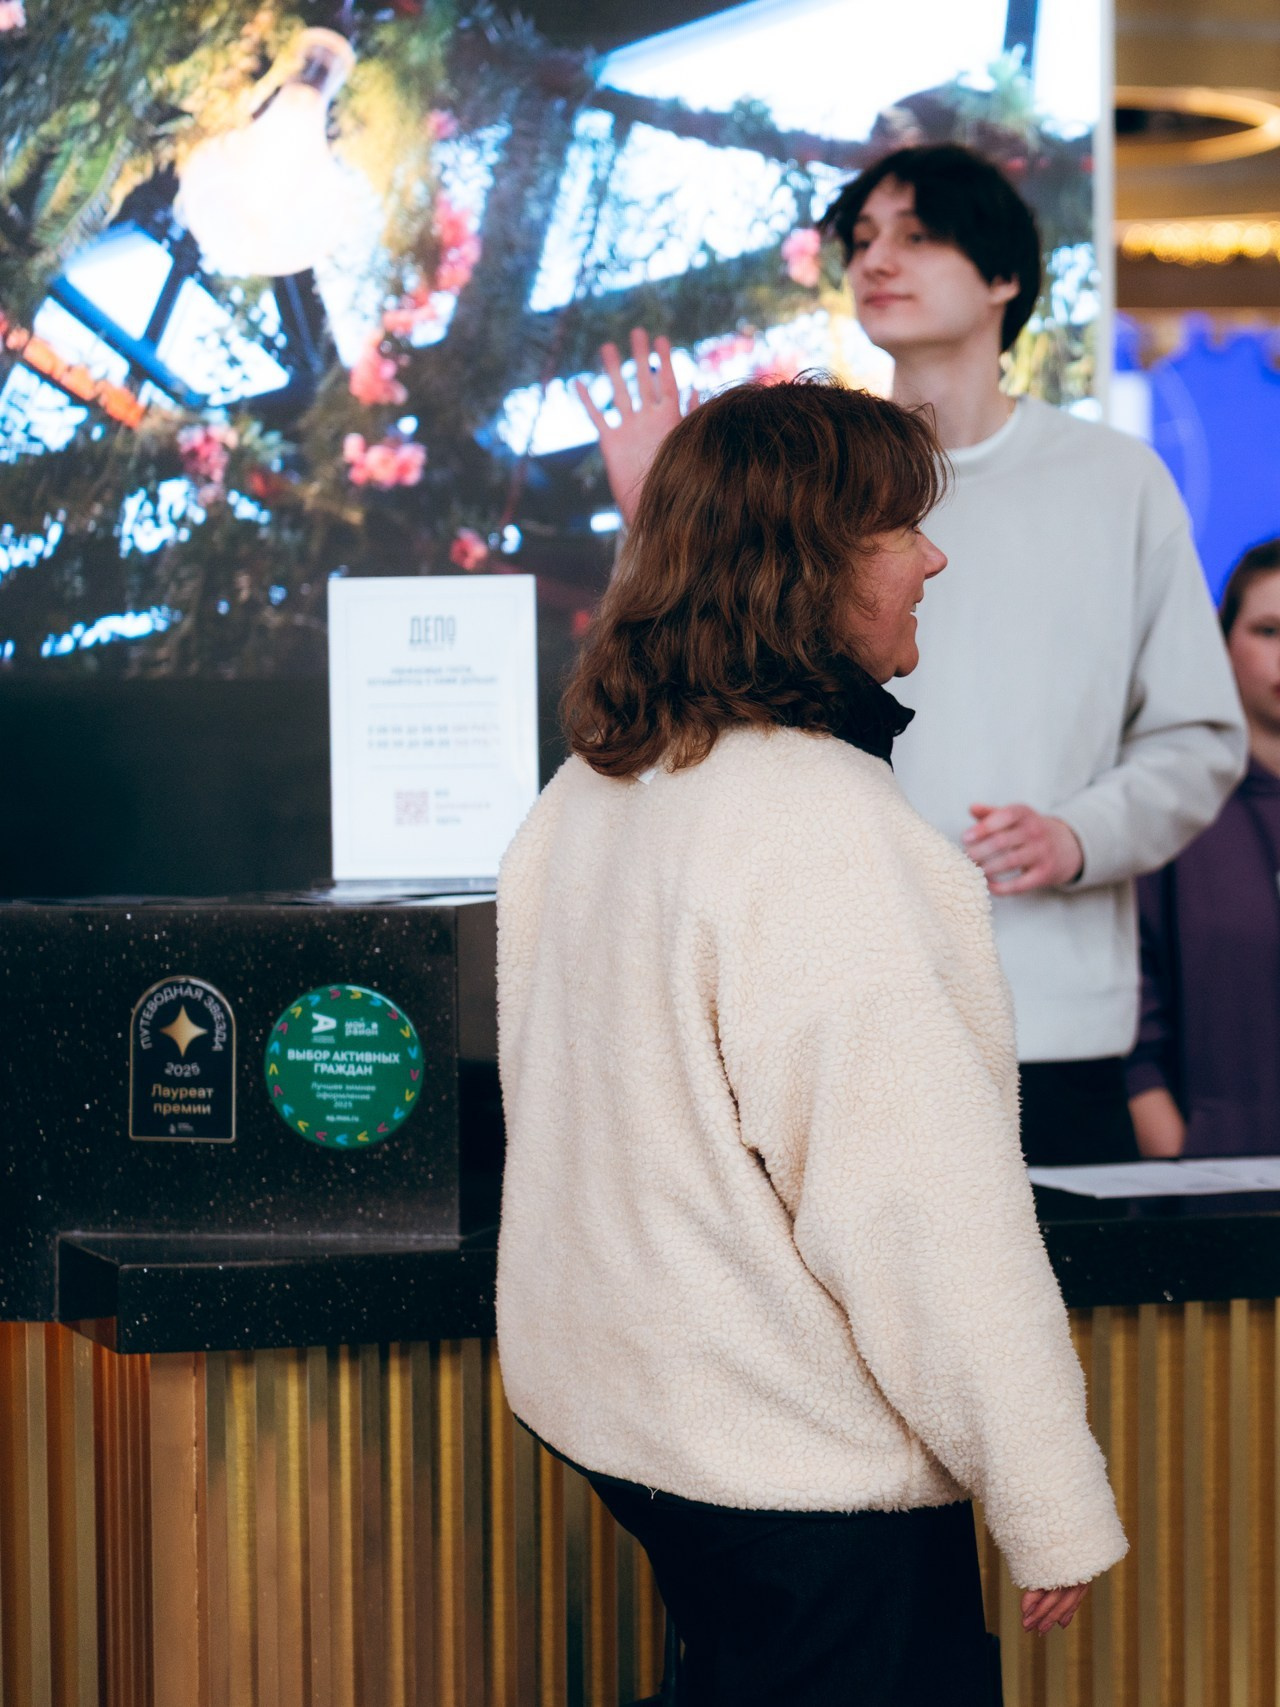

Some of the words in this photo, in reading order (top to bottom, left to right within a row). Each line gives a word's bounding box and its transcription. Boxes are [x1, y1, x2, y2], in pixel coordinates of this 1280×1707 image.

[409, 615, 456, 646] ДЕПО
[139, 984, 204, 1050] ПУТЕВОДНАЯ
[203, 995, 228, 1051] ЗВЕЗДА
[287, 1048, 331, 1062] ВЫБОР
[332, 1049, 400, 1064] АКТИВНЫХ
[314, 1062, 373, 1077] ГРАЖДАН
[151, 1083, 214, 1100] Лауреат
[153, 1102, 211, 1117] премии
